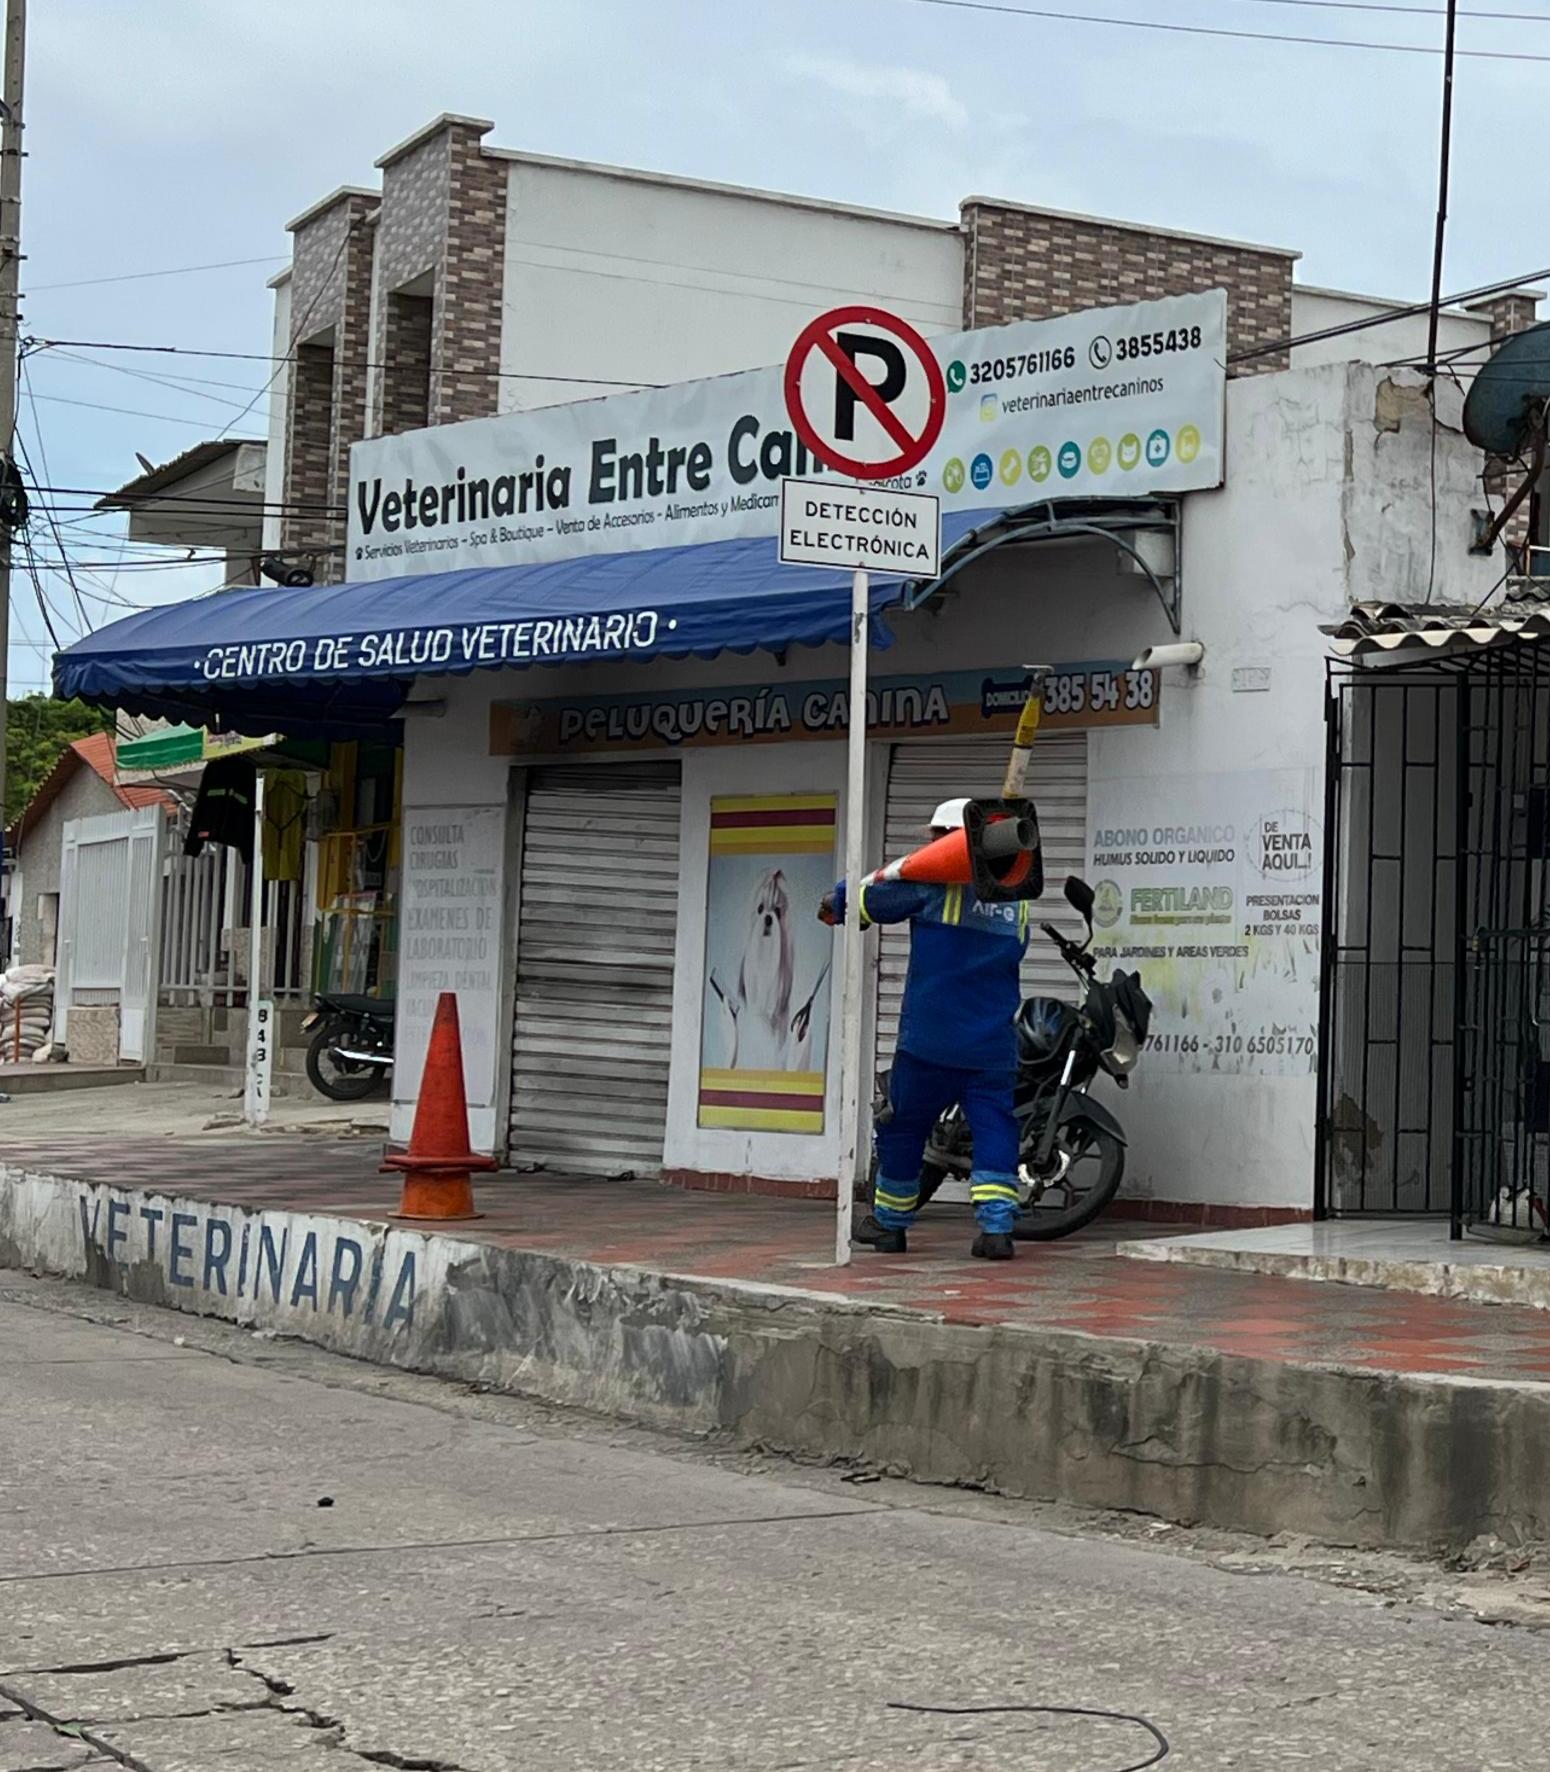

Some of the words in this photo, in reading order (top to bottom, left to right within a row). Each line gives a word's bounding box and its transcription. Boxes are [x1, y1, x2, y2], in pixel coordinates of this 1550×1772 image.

[970, 346, 1075, 385] 3205761166
[1116, 325, 1201, 361] 3855438
[834, 331, 907, 441] P
[1002, 376, 1164, 415] veterinariaentrecaninos
[357, 455, 571, 535] Veterinaria
[588, 437, 713, 504] Entre
[500, 524, 544, 543] Boutique
[587, 515, 601, 531] de
[664, 502, 719, 522] Alimentos
[805, 501, 917, 529] DETECCIÓN
[790, 530, 930, 560] ELECTRÓNICA
[203, 640, 305, 680] CENTRO
[313, 636, 354, 670] DE
[357, 628, 452, 668] SALUD
[461, 611, 658, 660] VETERINARIO
[1043, 670, 1086, 713] 385
[1090, 671, 1118, 711] 54
[1124, 669, 1153, 710] 38
[410, 824, 465, 846] CONSULTA
[1093, 828, 1148, 848] ABONO
[1152, 825, 1235, 846] ORGANICO
[1264, 821, 1279, 833] DE
[1262, 833, 1312, 851] VENTA
[1093, 851, 1132, 866] HUMUS
[1134, 850, 1175, 866] SOLIDO
[1177, 850, 1187, 864] Y
[1187, 848, 1235, 865] LIQUIDO
[1130, 886, 1234, 913] FERTILAND
[1246, 894, 1320, 907] PRESENTACION
[407, 906, 469, 931] EXAMENES
[476, 906, 492, 931] DE
[1263, 909, 1302, 921] BOLSAS
[1244, 925, 1251, 936] 2
[1252, 924, 1273, 936] KGS
[1093, 947, 1119, 959] PARA
[1176, 945, 1208, 958] AREAS
[1209, 945, 1249, 958] VERDES
[1143, 1034, 1199, 1053] 761166
[1214, 1035, 1242, 1053] 310
[1247, 1035, 1314, 1055] 6505170
[79, 1195, 417, 1331] VETERINARIA
